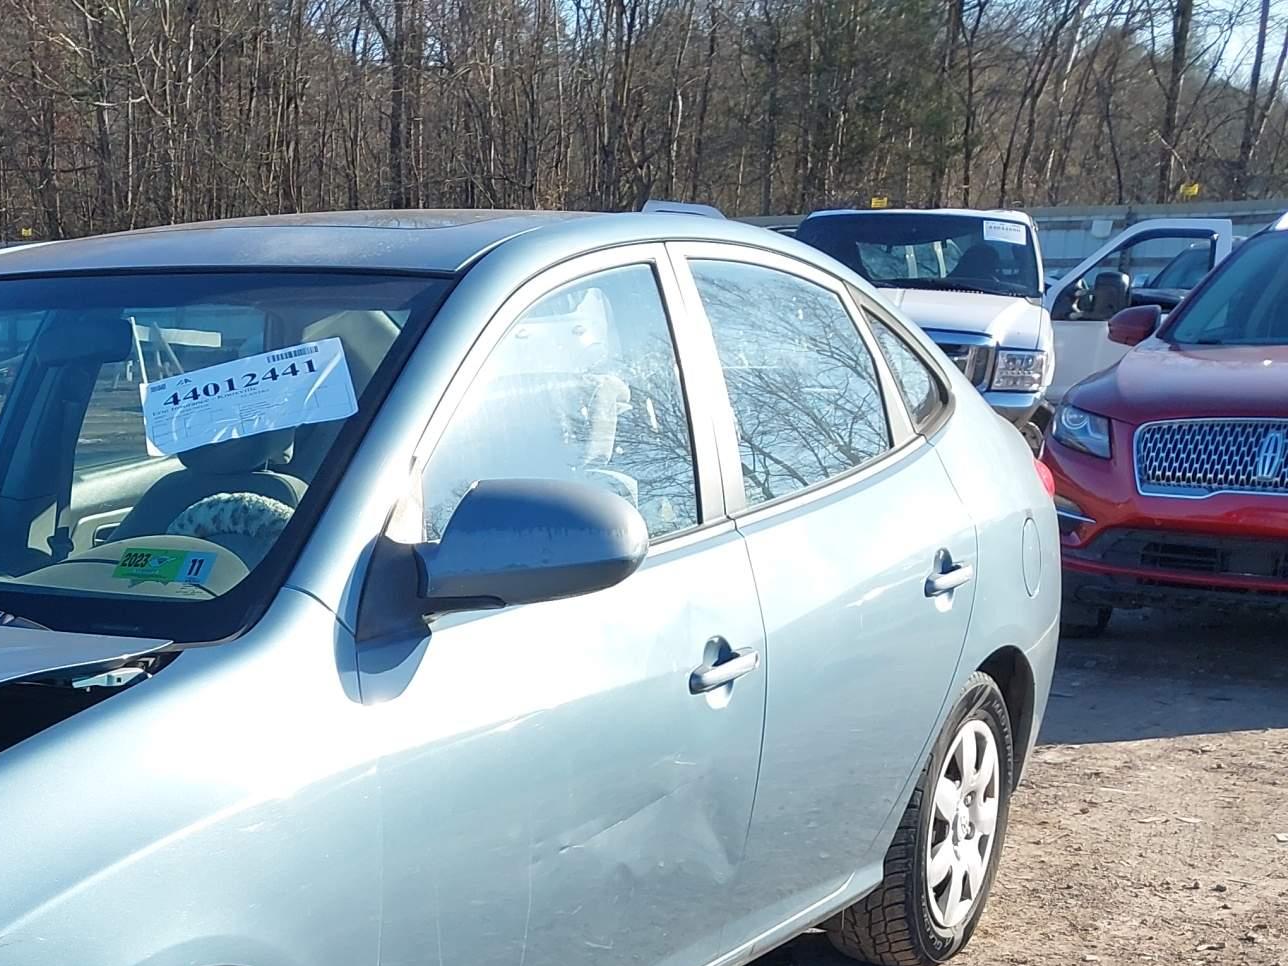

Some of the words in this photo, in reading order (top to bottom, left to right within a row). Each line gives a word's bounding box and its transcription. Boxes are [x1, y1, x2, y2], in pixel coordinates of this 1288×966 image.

[162, 358, 318, 407] 44012441
[121, 552, 151, 568] 2023
[187, 558, 205, 576] 11
